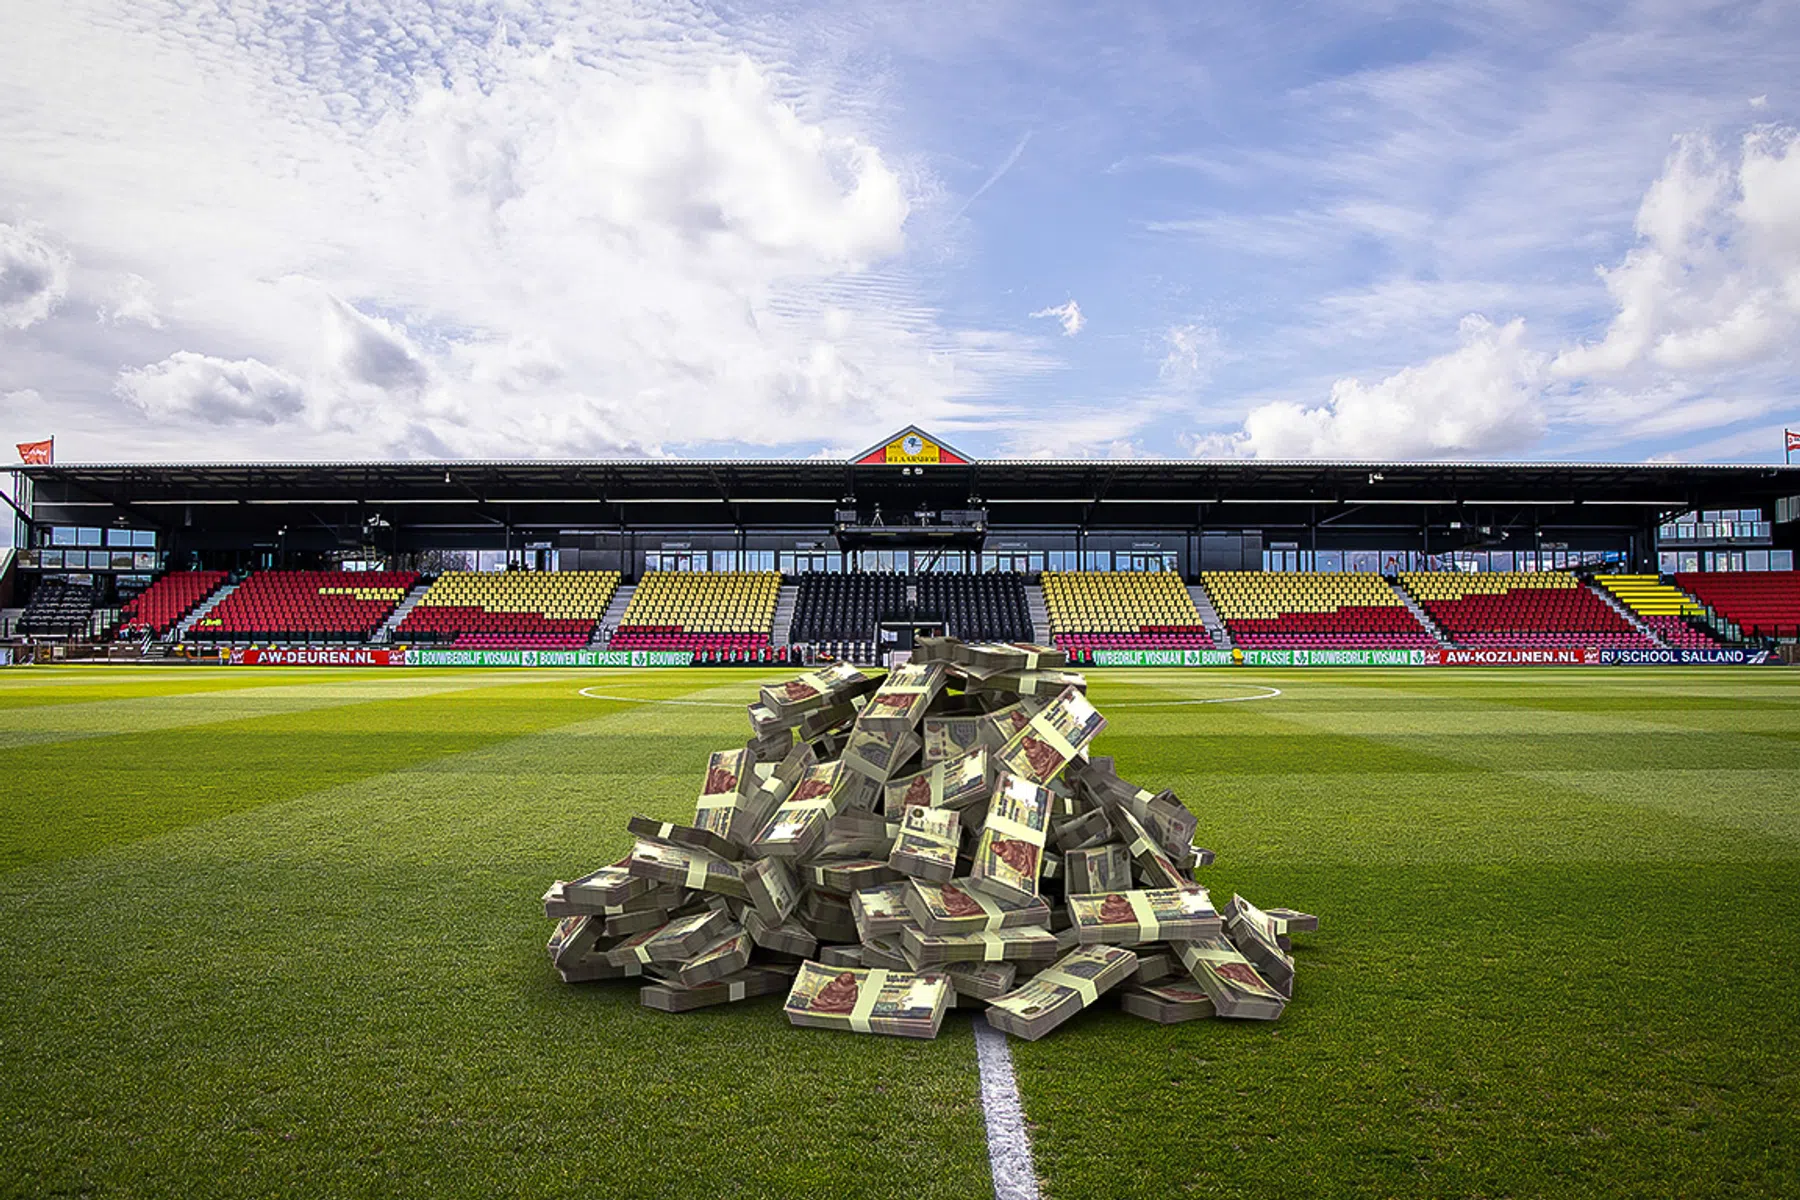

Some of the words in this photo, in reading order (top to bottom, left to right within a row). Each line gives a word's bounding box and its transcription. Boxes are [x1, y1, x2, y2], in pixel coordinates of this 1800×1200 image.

[257, 651, 376, 664] AW-DEUREN.NL
[422, 652, 482, 665] BOUWBEDRIJF
[484, 652, 519, 665] VOSMAN
[539, 652, 576, 665] BOUWEN
[578, 652, 596, 665] MET
[598, 652, 629, 665] PASSIE
[650, 652, 694, 665] BOUWBED
[1093, 651, 1143, 665] UWBEDRIJF
[1145, 651, 1180, 664] VOSMAN
[1202, 651, 1233, 664] BOUWE
[1261, 651, 1290, 664] PASSIE
[1311, 651, 1370, 664] BOUWBEDRIJF
[1371, 651, 1408, 664] VOSMAN
[1446, 651, 1579, 662] AW-KOZIJNEN.NL
[1681, 651, 1743, 662] SALLAND
